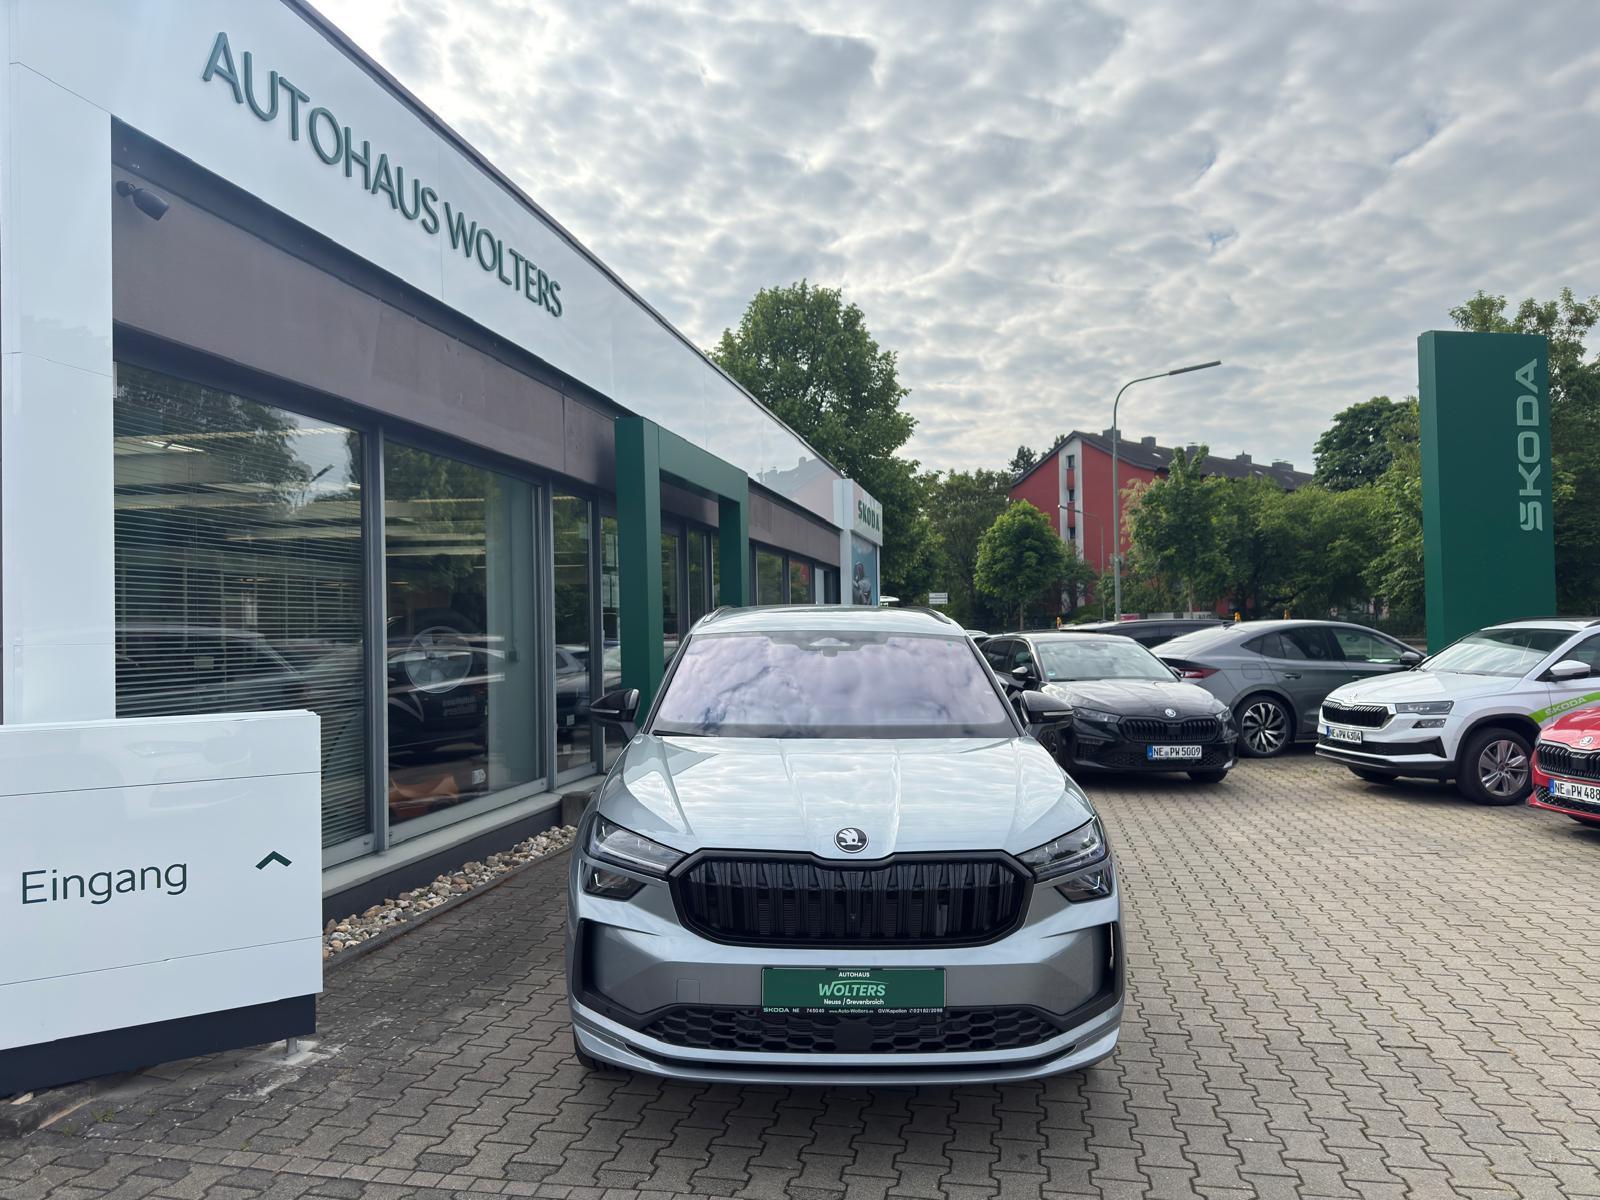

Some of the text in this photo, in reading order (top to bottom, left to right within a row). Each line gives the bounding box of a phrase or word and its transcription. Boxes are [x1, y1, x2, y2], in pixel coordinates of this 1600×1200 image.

[202, 31, 563, 317] AUTOHAUS WOLTERS
[1347, 731, 1361, 741] 4304
[1153, 747, 1201, 757] NE PW 5009
[1555, 782, 1565, 794] NE
[1571, 785, 1582, 797] PW
[22, 863, 187, 905] Eingang
[818, 980, 886, 996] WOLTERS
